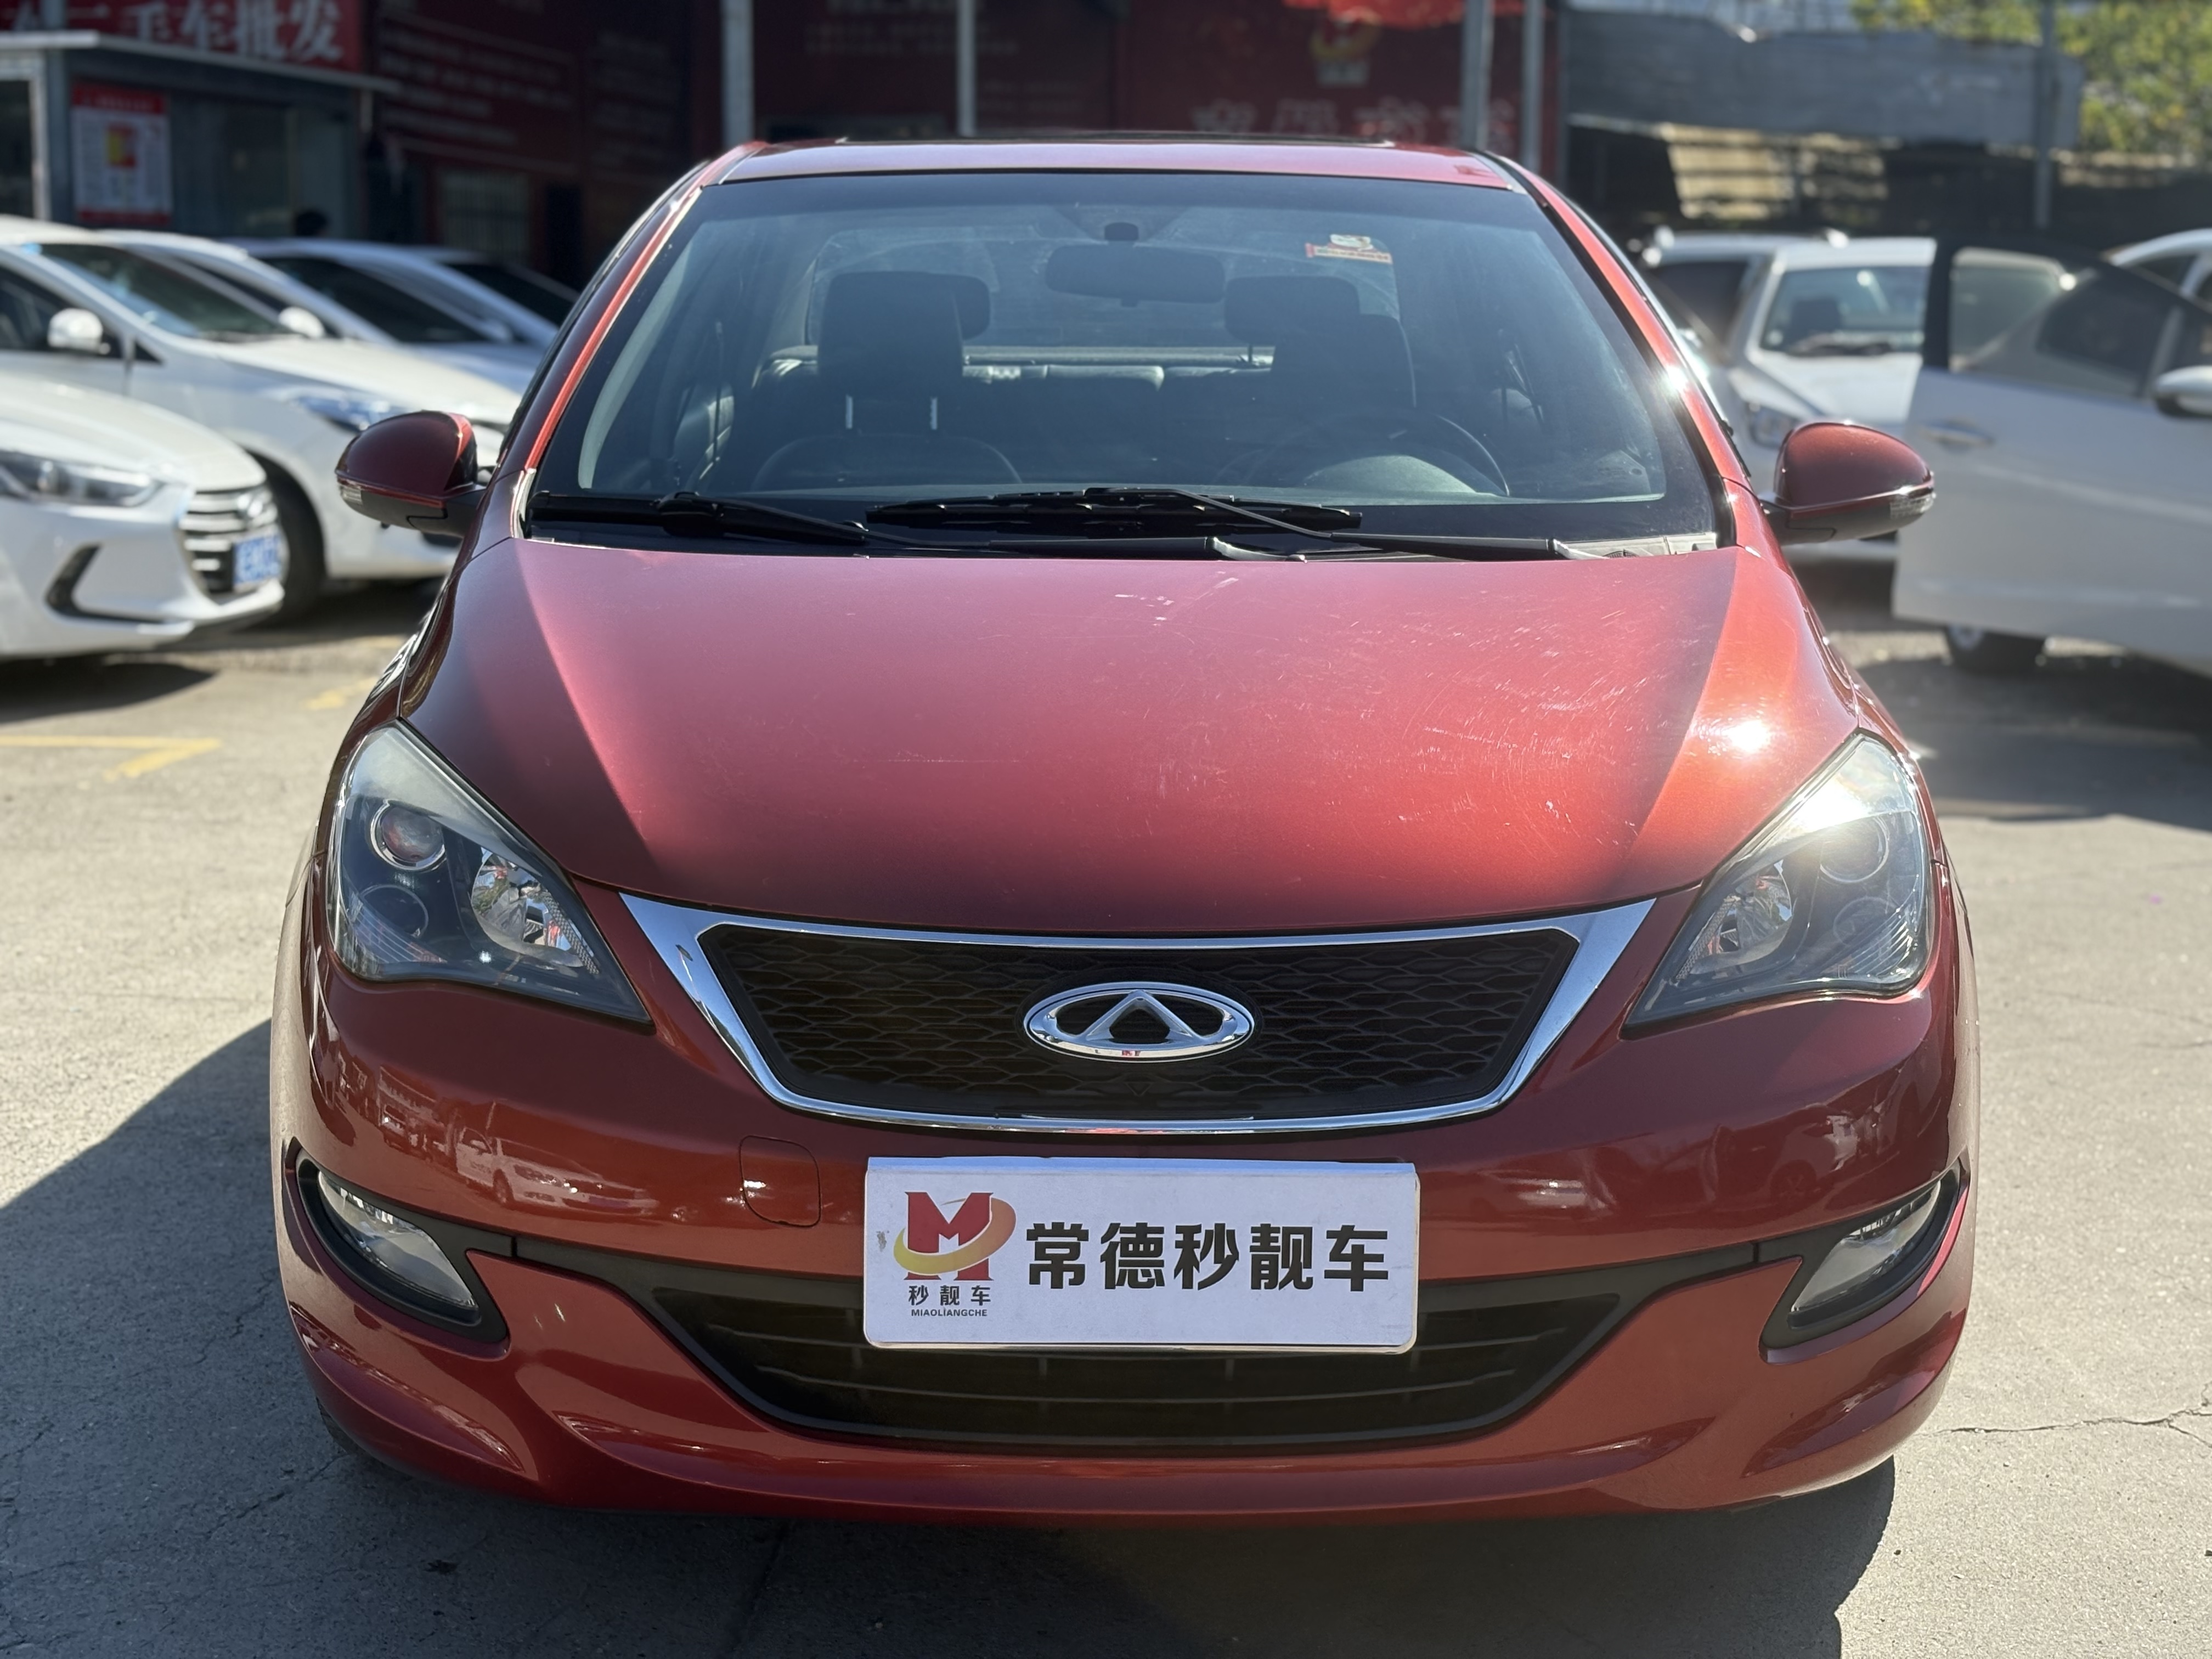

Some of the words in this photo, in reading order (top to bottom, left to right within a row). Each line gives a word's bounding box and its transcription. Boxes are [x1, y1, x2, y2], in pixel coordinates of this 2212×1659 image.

[1026, 1221, 1389, 1292] 常德秒靓车
[909, 1285, 991, 1306] 秒靓车
